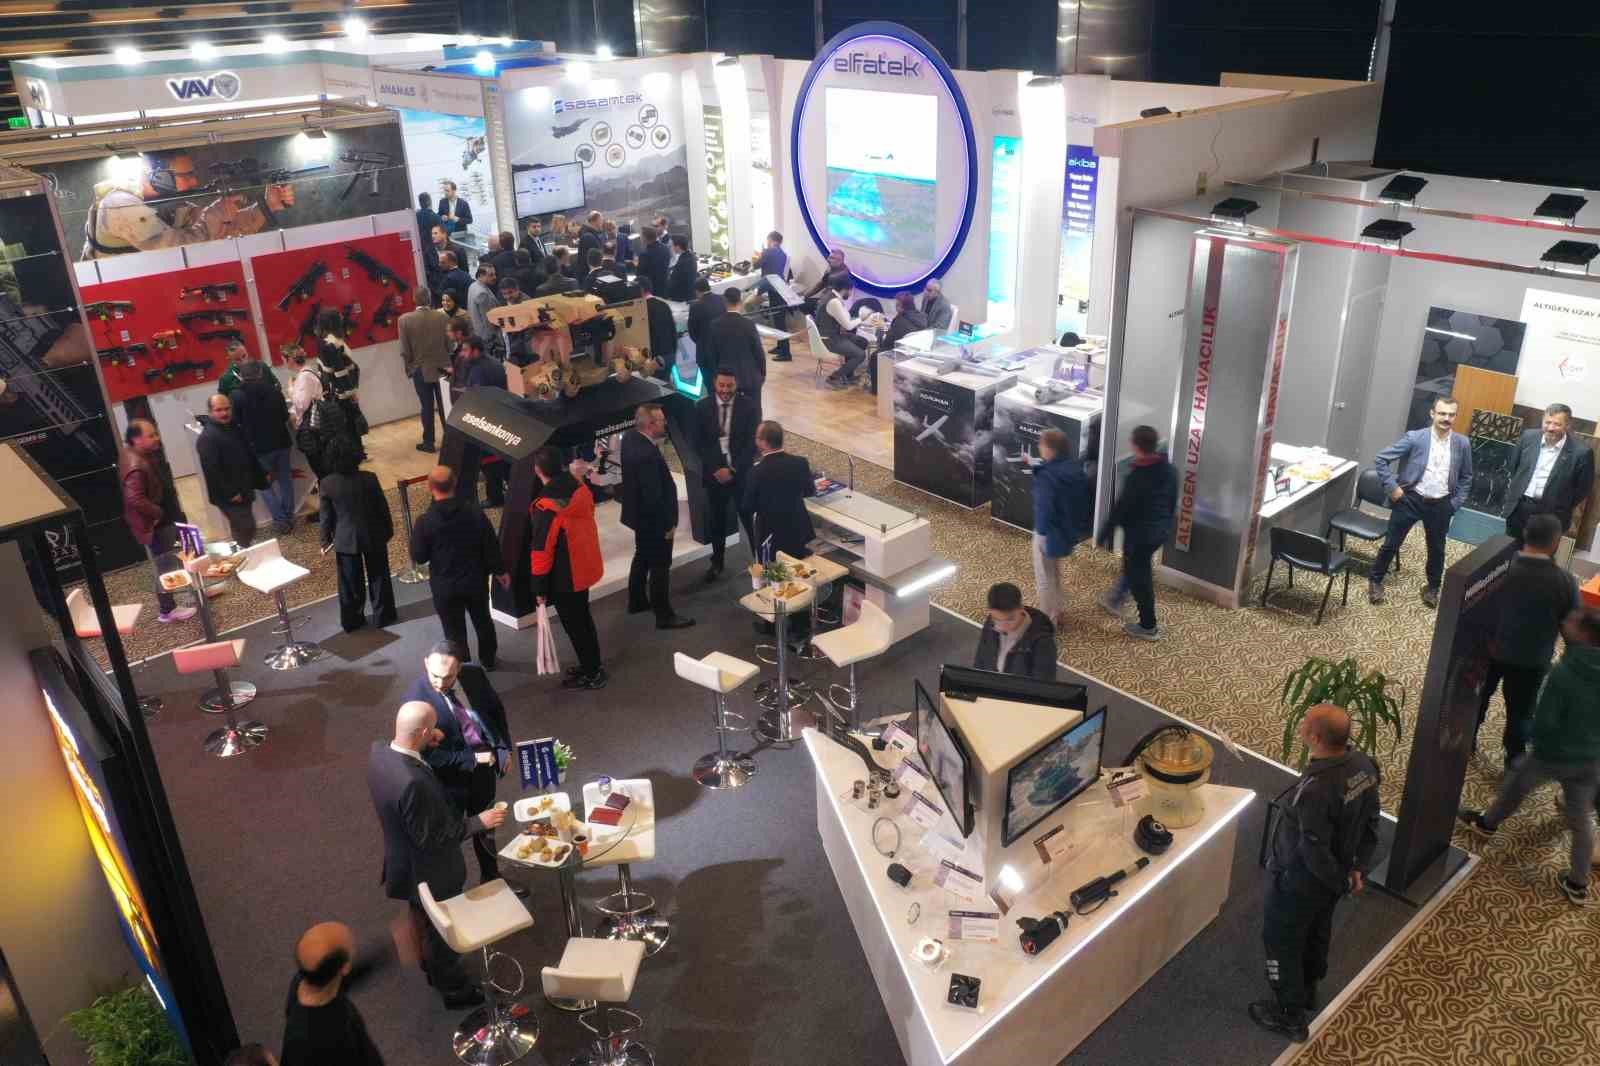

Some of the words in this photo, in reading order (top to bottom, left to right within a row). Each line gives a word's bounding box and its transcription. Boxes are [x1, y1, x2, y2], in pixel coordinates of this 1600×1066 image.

[834, 53, 919, 77] elfatek
[169, 78, 215, 99] VAV
[564, 93, 643, 111] sasamtek
[1193, 306, 1217, 411] HAVACILIK
[462, 412, 521, 446] aselsankonya
